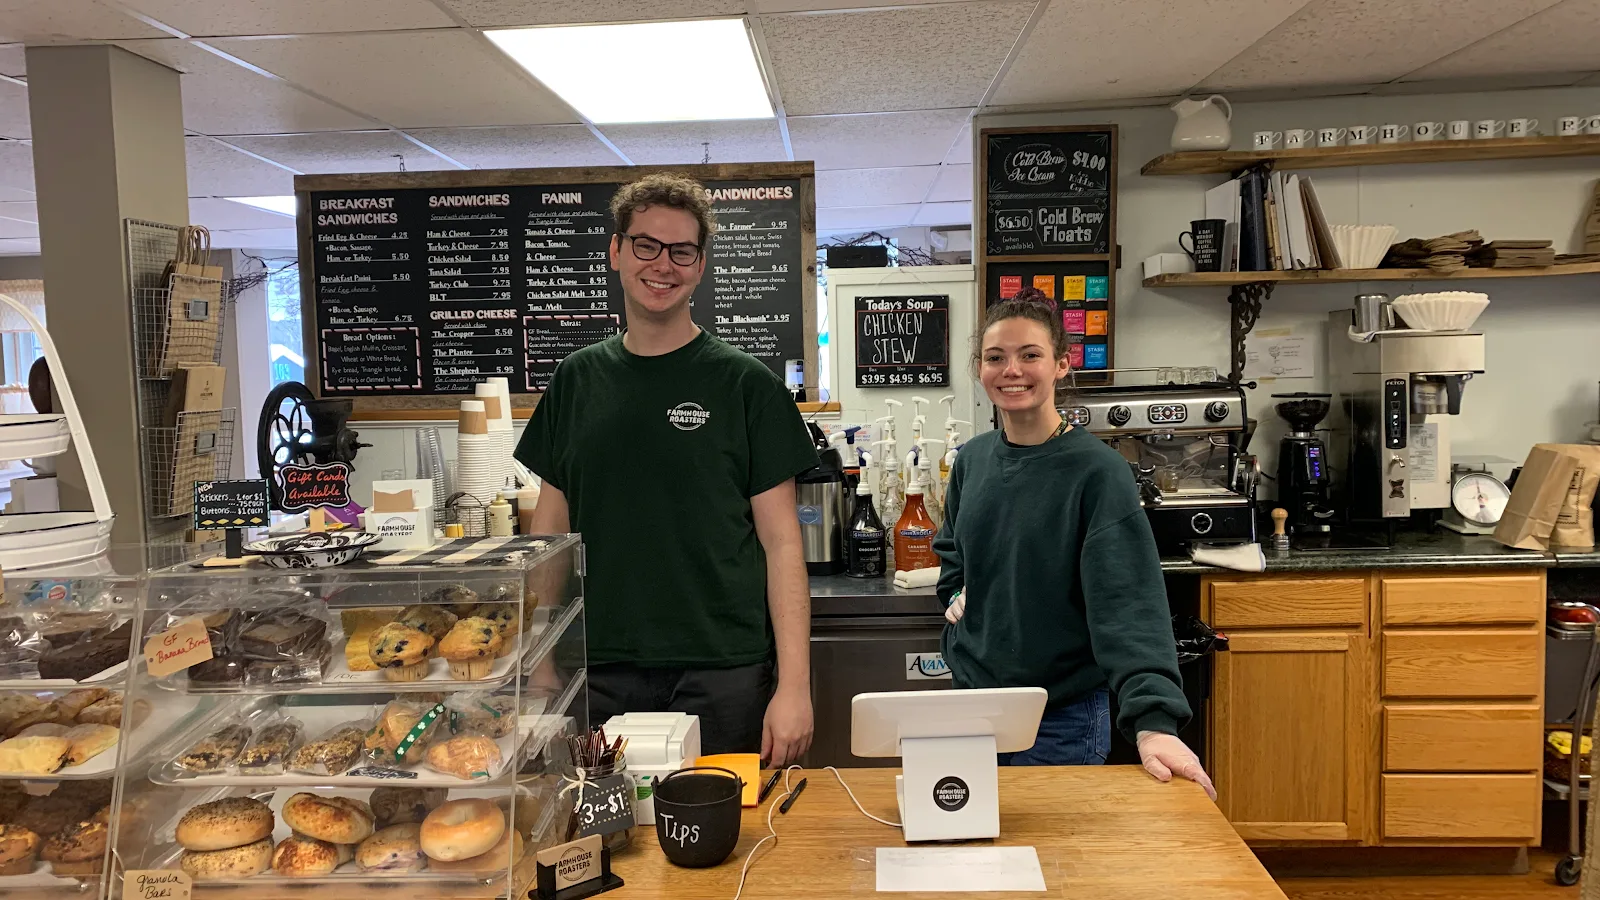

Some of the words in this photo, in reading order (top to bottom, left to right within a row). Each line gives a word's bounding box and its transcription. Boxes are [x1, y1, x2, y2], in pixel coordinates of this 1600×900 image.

[1012, 151, 1036, 166] Cold
[1036, 151, 1064, 165] Brew
[1072, 150, 1106, 171] $4.00
[1028, 167, 1056, 181] Cream
[542, 193, 582, 204] PANINI
[705, 186, 793, 200] SANDWICHES
[320, 198, 394, 209] BREAKFAST
[429, 194, 510, 207] SANDWICHES
[318, 213, 398, 225] SANDWICHES
[998, 216, 1029, 228] $6.50
[1038, 208, 1067, 225] Cold
[1072, 207, 1104, 224] Brew
[1044, 226, 1092, 242] Floats
[427, 243, 450, 251] Turkey
[737, 250, 755, 258] Triangle
[429, 281, 451, 289] Turkey
[493, 279, 510, 287] 9.75
[527, 279, 548, 287] Turkey
[866, 300, 902, 312] Today's
[907, 299, 933, 312] Soup
[356, 316, 378, 324] Turkey
[430, 311, 474, 320] GRILLED
[476, 309, 517, 319] CHEESE
[864, 312, 922, 336] CHICKEN
[366, 334, 396, 342] Options:
[495, 328, 512, 336] 5.50
[755, 342, 776, 350] Triangle
[873, 336, 917, 364] STEW
[450, 367, 479, 376] Shepherd
[862, 374, 885, 384] $3.95
[889, 374, 913, 383] $4.95
[919, 373, 942, 383] $6.95
[667, 409, 710, 418] FARMHOUSE
[670, 416, 706, 424] ROASTERS
[287, 471, 312, 483] Gift
[316, 470, 346, 482] Cards
[198, 482, 213, 493] NEW
[289, 484, 341, 499] Available
[163, 634, 178, 646] GF
[155, 646, 185, 664] Banana
[582, 803, 595, 824] 3
[595, 802, 608, 812] for
[608, 792, 625, 814] $1
[660, 812, 700, 848] Tips
[555, 851, 592, 869] FARMHOUSE
[558, 861, 591, 876] ROASTERS
